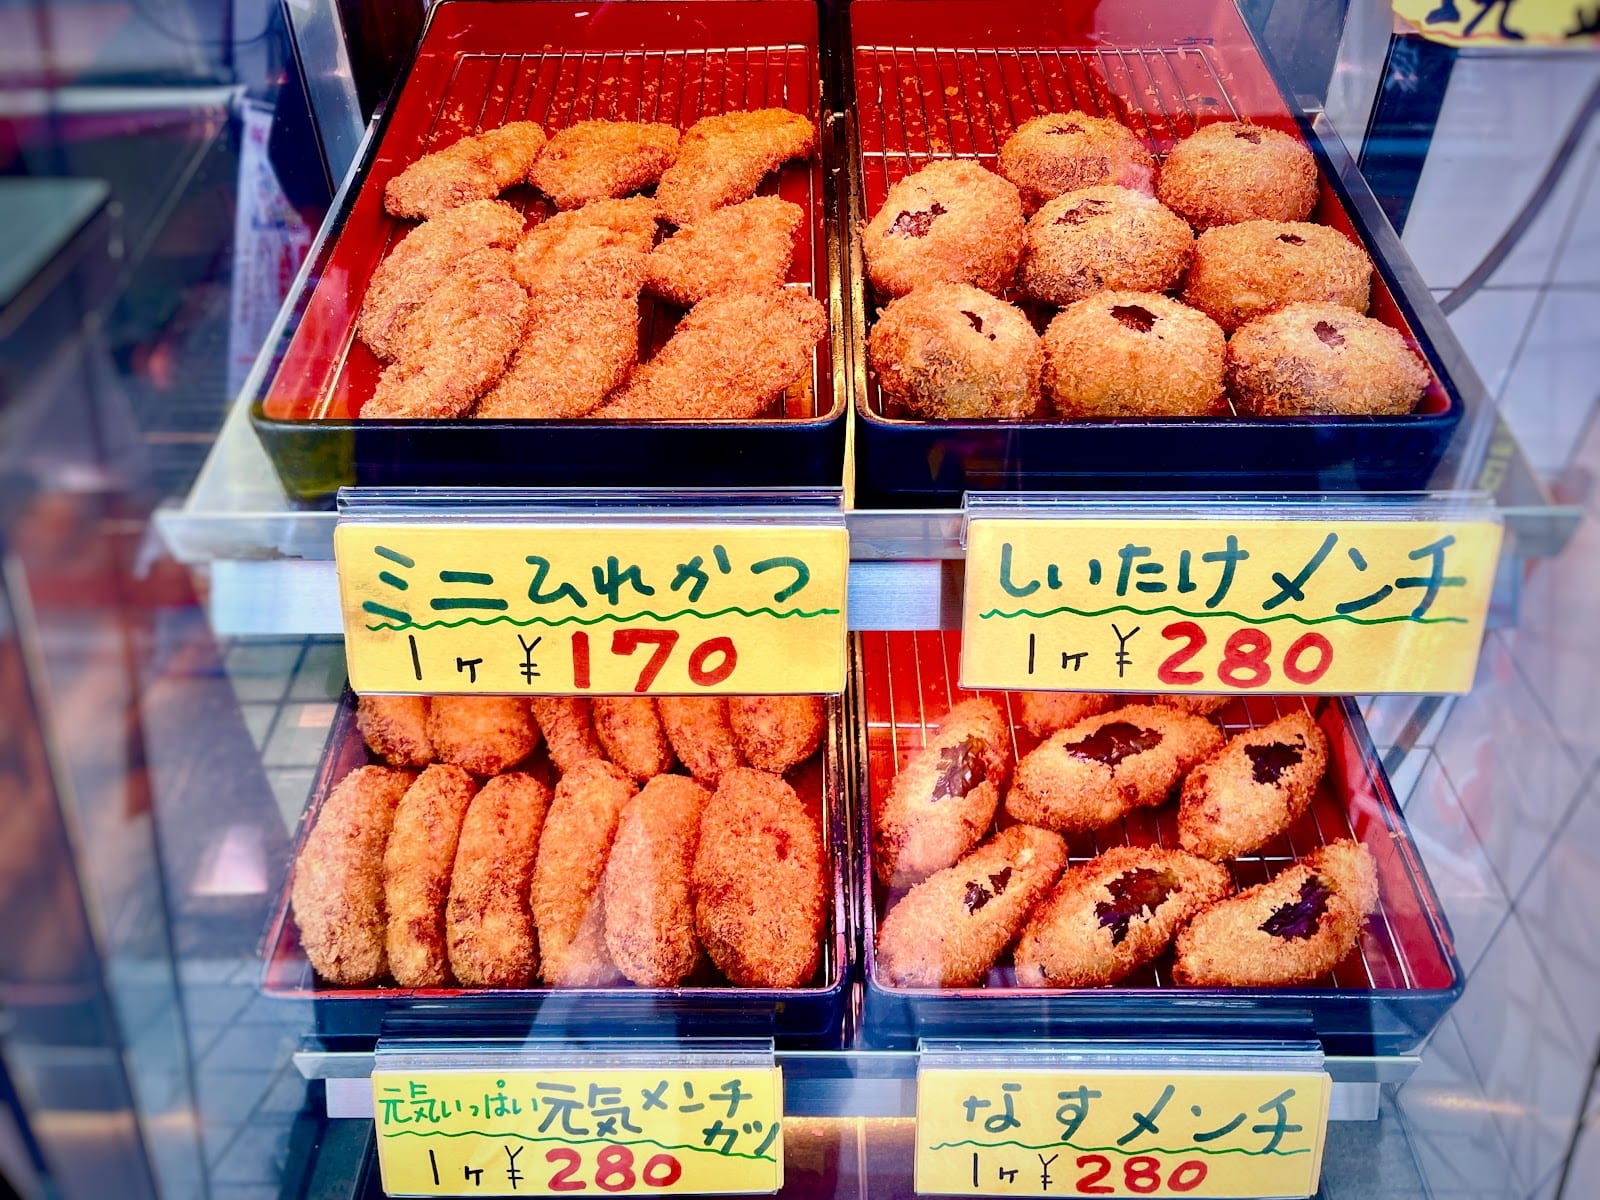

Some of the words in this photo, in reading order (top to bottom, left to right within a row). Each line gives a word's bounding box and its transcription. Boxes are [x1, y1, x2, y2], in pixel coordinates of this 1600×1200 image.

[999, 534, 1467, 619] しいたけメンチ
[962, 1084, 1303, 1154] なすメンチ
